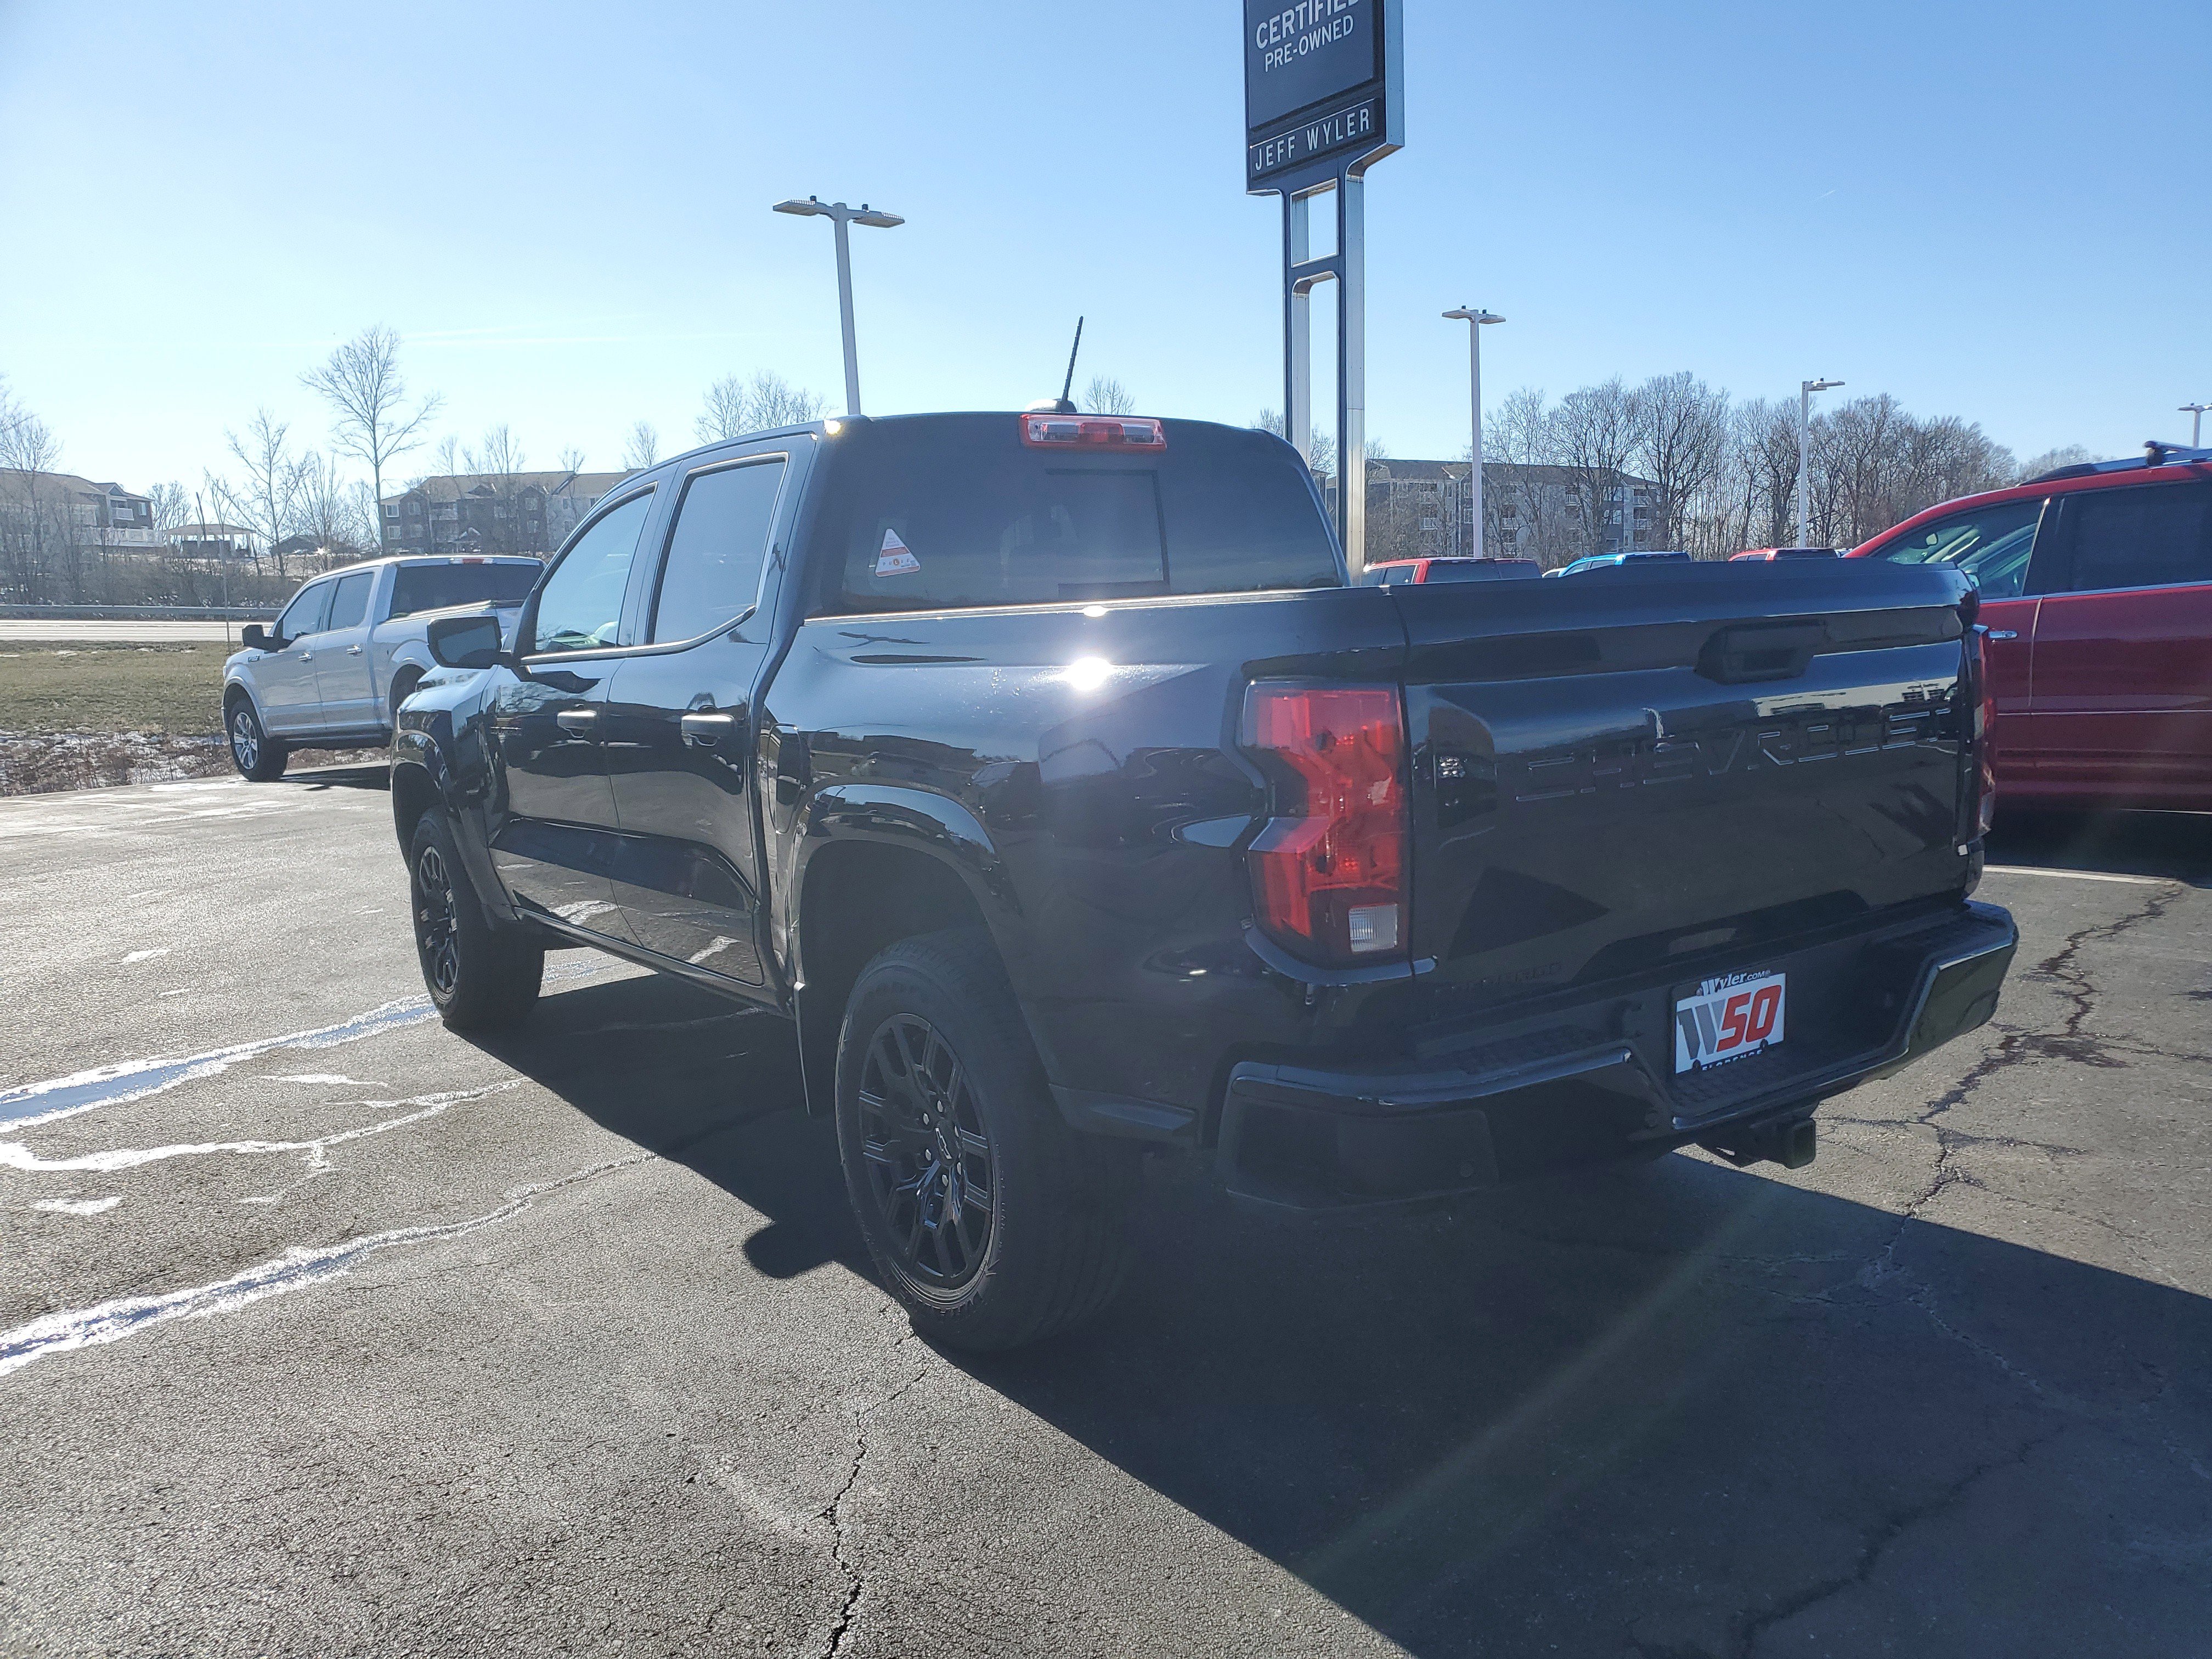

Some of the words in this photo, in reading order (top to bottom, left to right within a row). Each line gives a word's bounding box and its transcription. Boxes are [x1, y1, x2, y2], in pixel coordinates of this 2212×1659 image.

[1256, 0, 1359, 49] CERTIFIE
[1264, 15, 1354, 72] PRE-OWNED
[1255, 136, 1295, 171] JEFF
[1306, 108, 1370, 151] WYLER
